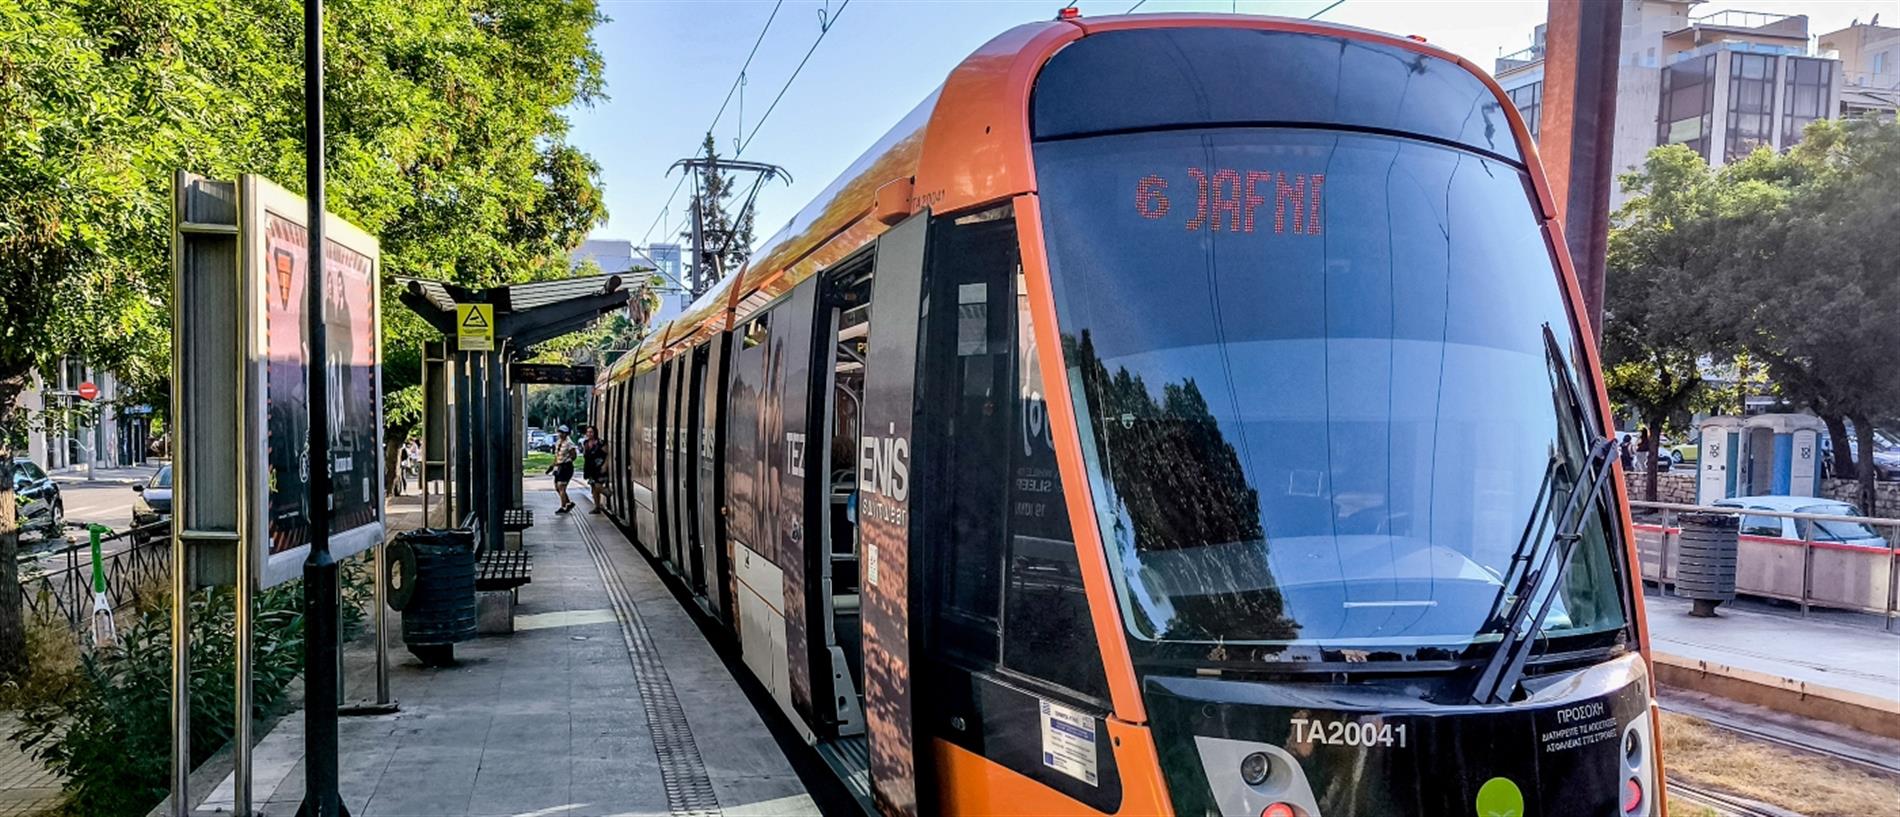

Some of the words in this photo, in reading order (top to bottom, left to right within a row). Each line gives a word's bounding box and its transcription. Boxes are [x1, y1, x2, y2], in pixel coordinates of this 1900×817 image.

[1136, 174, 1170, 219] 6
[1557, 702, 1604, 724] ΠΡΟΣΟΧΗ
[1290, 718, 1406, 748] TA20041
